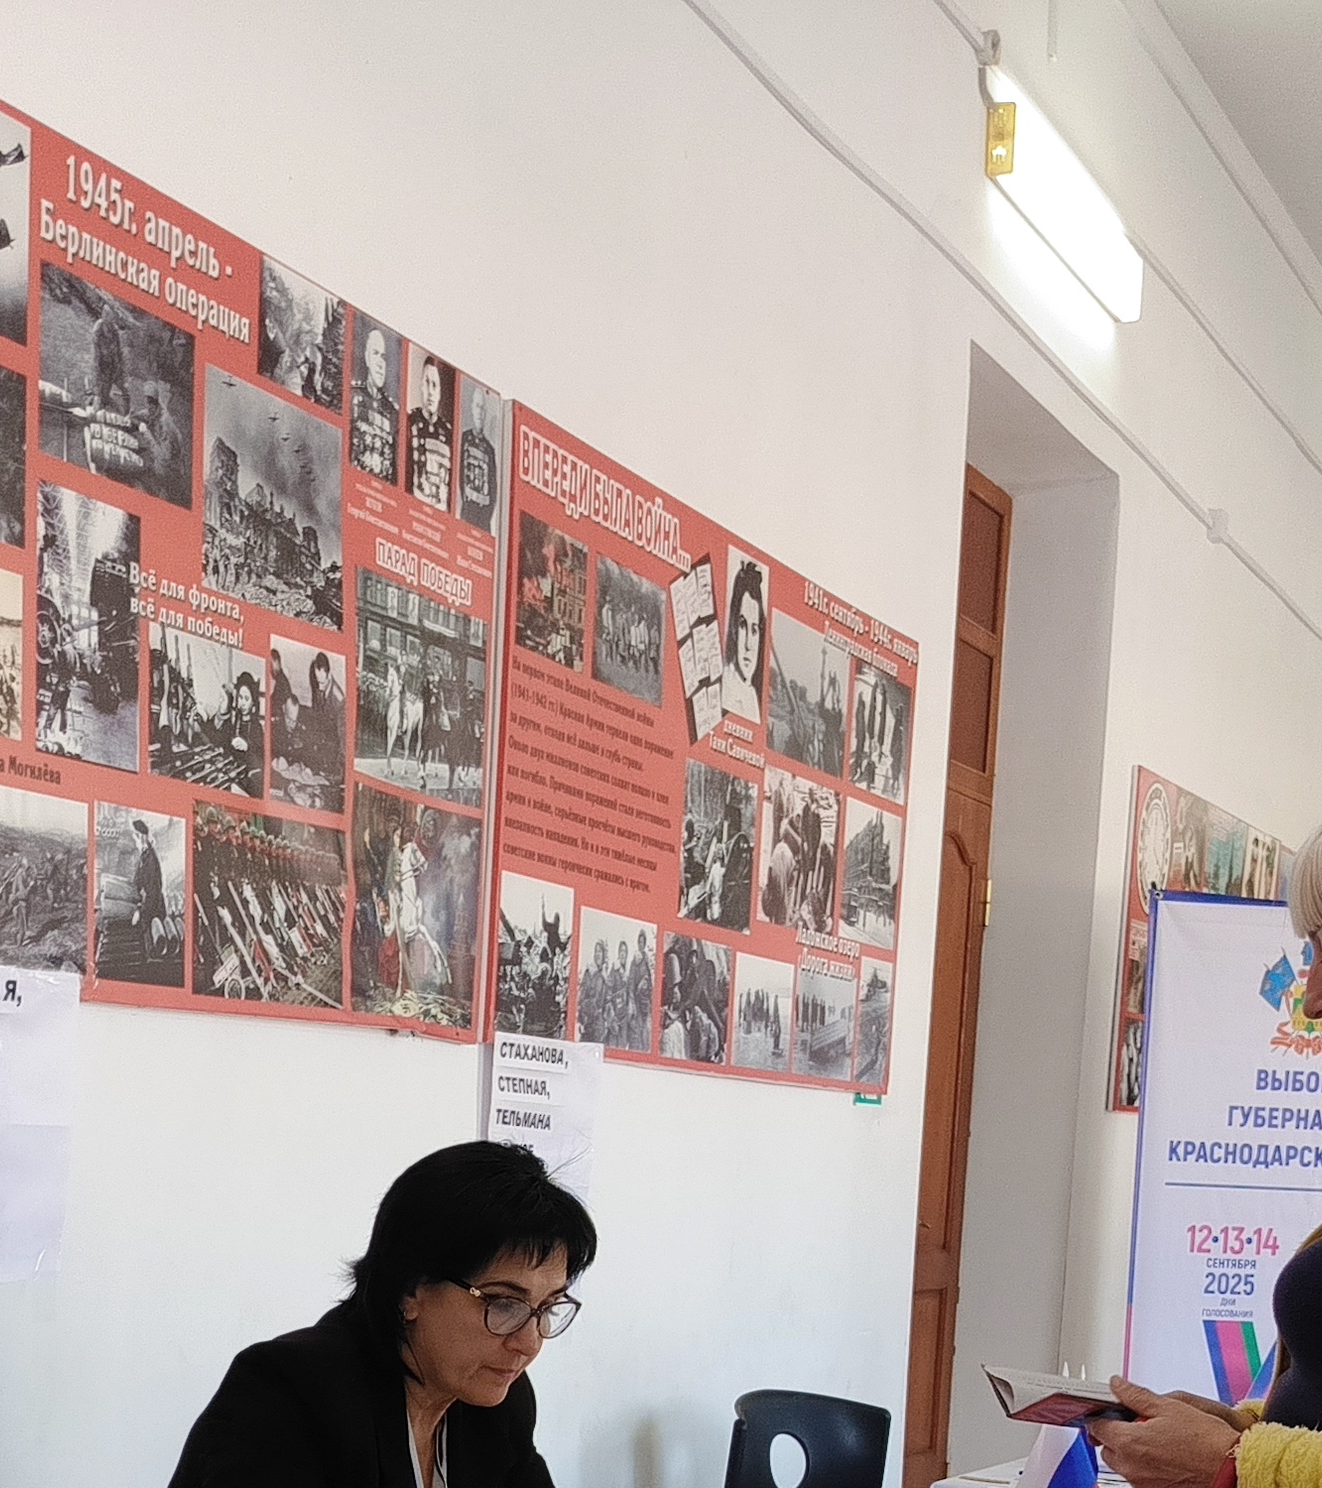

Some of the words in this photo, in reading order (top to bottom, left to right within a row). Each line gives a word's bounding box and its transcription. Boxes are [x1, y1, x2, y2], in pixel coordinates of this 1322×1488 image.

[66, 155, 137, 236] 1945г.
[144, 211, 220, 279] апрель
[39, 199, 161, 297] Берлинская
[164, 277, 251, 345] операция
[519, 424, 590, 519] ВПЕРЕДИ
[590, 468, 634, 544] БЫЛА
[376, 537, 418, 586] ПАРАД
[420, 557, 472, 606] ПОБЕДЫ
[129, 562, 157, 592] Всё
[159, 577, 186, 601] для
[188, 583, 245, 624] фронта,
[129, 597, 157, 621] всё
[158, 606, 185, 629] для
[187, 615, 244, 648] победы!
[8, 755, 61, 785] Могилёва
[500, 1041, 569, 1069] СТАХАНОВА,
[498, 1075, 550, 1100] СТЕПНАЯ,
[496, 1108, 551, 1130] ТЕЛЬМАНА
[1203, 1272, 1255, 1296] 2025
[1206, 1258, 1257, 1270] СЕНТЯБРЯ
